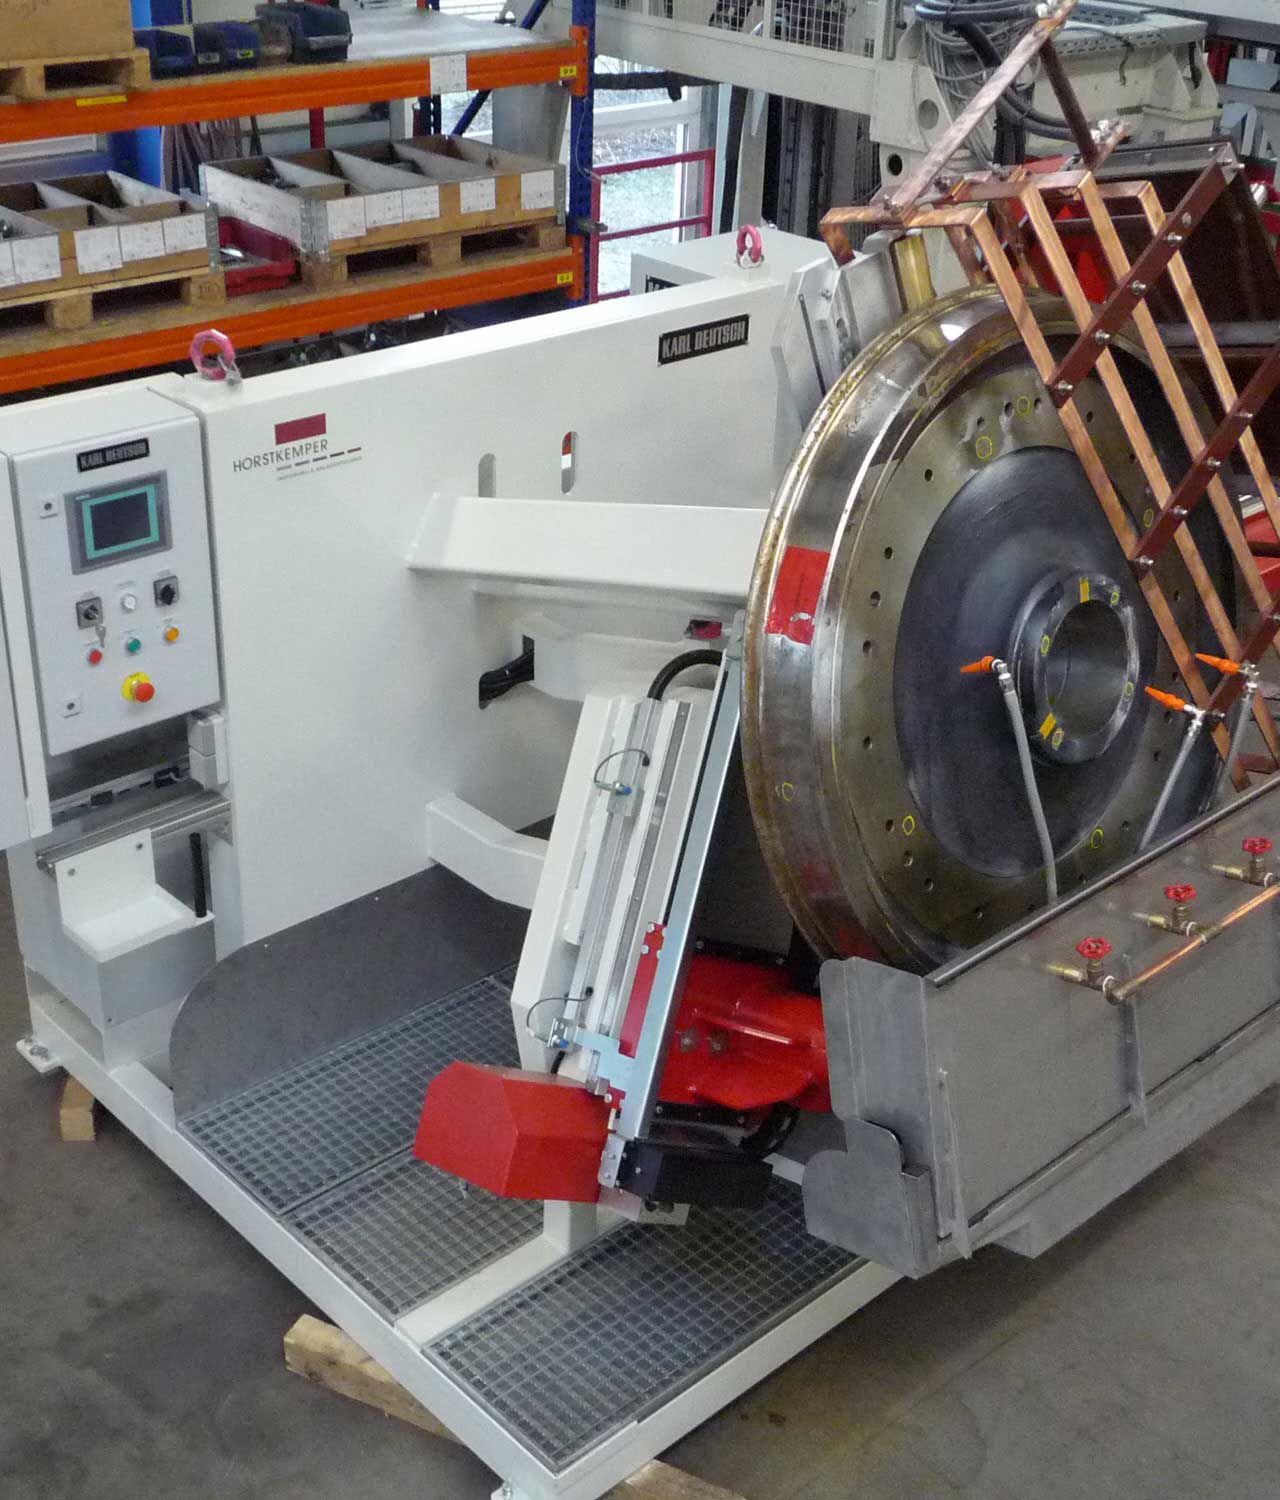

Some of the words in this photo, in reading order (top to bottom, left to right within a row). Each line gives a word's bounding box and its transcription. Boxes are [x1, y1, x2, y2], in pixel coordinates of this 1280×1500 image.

[661, 333, 692, 359] KARL
[694, 320, 746, 350] DEUTSCH
[232, 439, 329, 473] HORSTKEMPER
